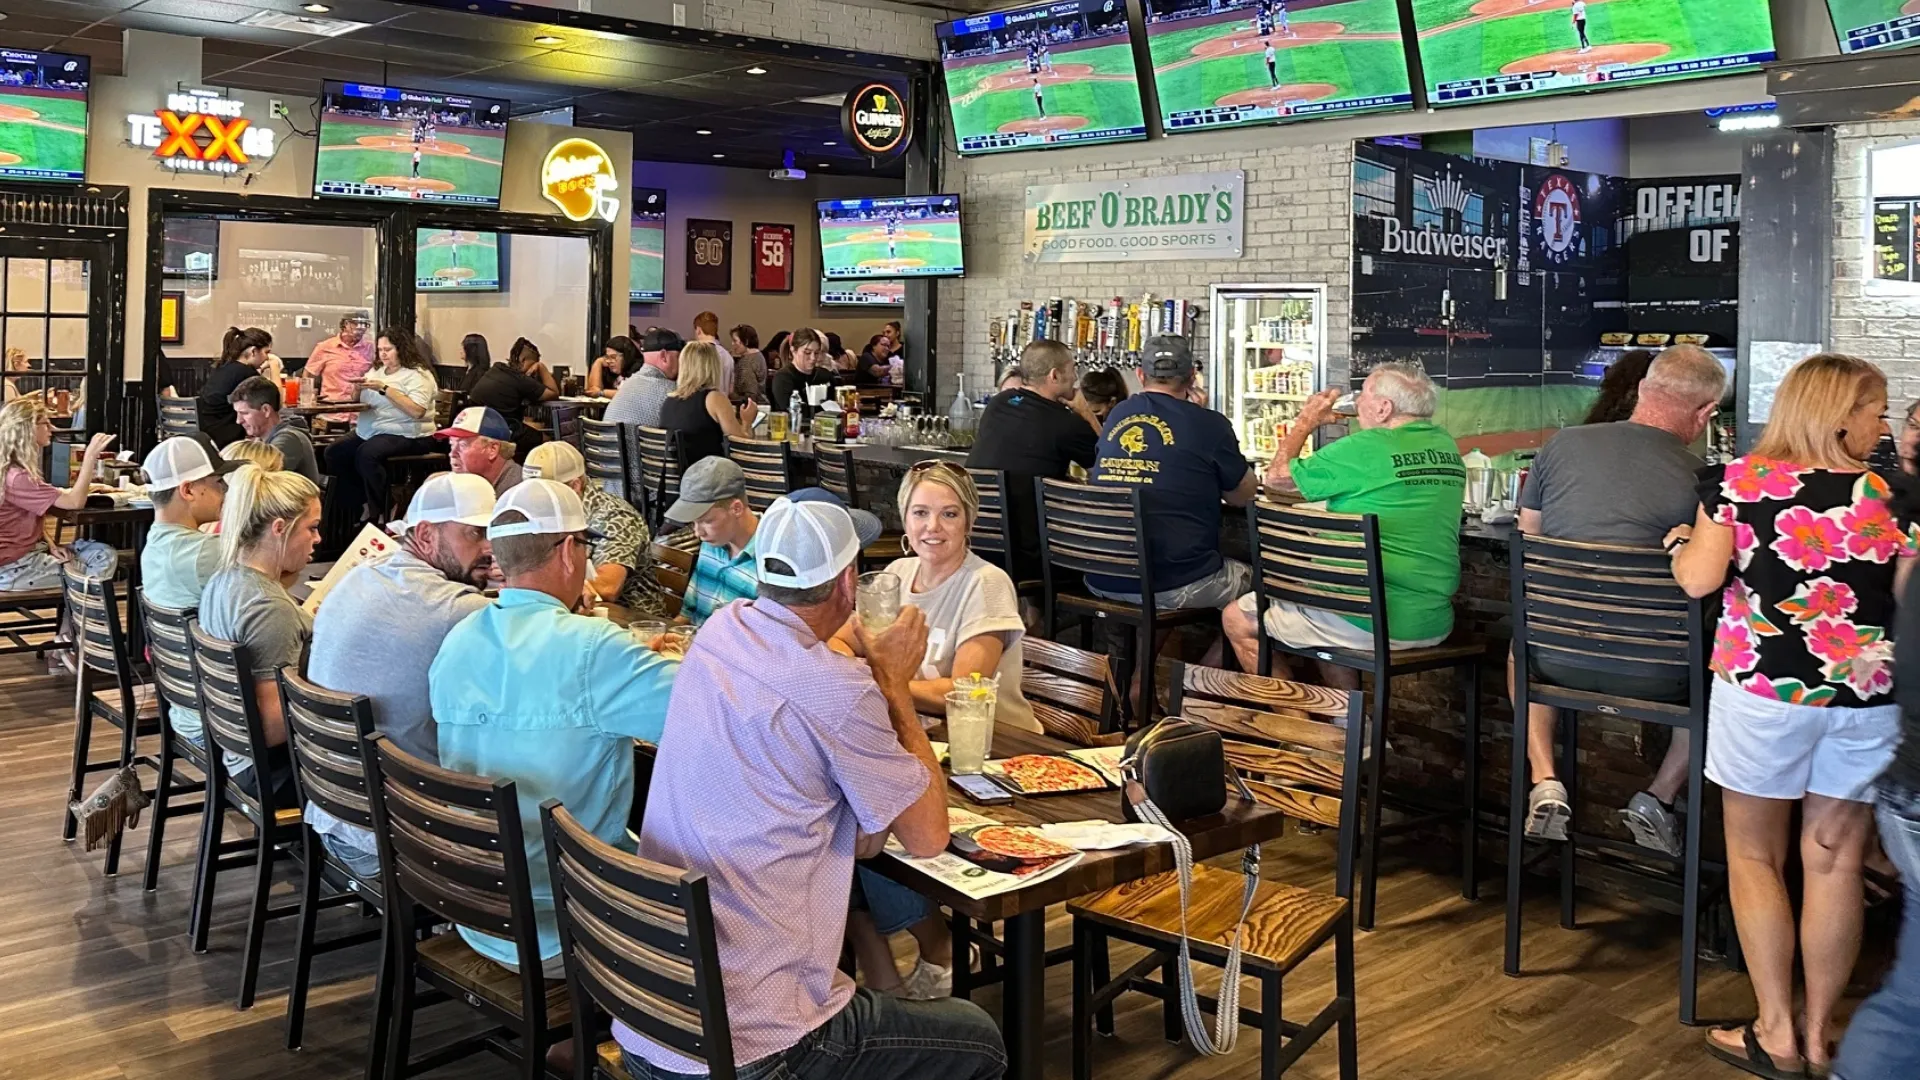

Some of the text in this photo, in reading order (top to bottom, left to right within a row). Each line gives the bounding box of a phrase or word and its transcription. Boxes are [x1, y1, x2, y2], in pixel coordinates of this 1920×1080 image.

[855, 109, 903, 128] GUINNESS
[1540, 177, 1576, 202] TEXAS
[1035, 199, 1097, 231] BEEF
[1123, 184, 1233, 228] BRADY'S
[1549, 202, 1568, 242] T
[1042, 238, 1077, 250] GOOD
[1120, 235, 1158, 247] GOOD
[1161, 233, 1217, 246] SPORTS
[1381, 216, 1506, 260] Budweiser
[1689, 229, 1731, 263] OF
[695, 237, 723, 266] 90
[761, 241, 785, 267] 58
[1391, 452, 1426, 468] BEEF
[1404, 478, 1440, 486] BOARD
